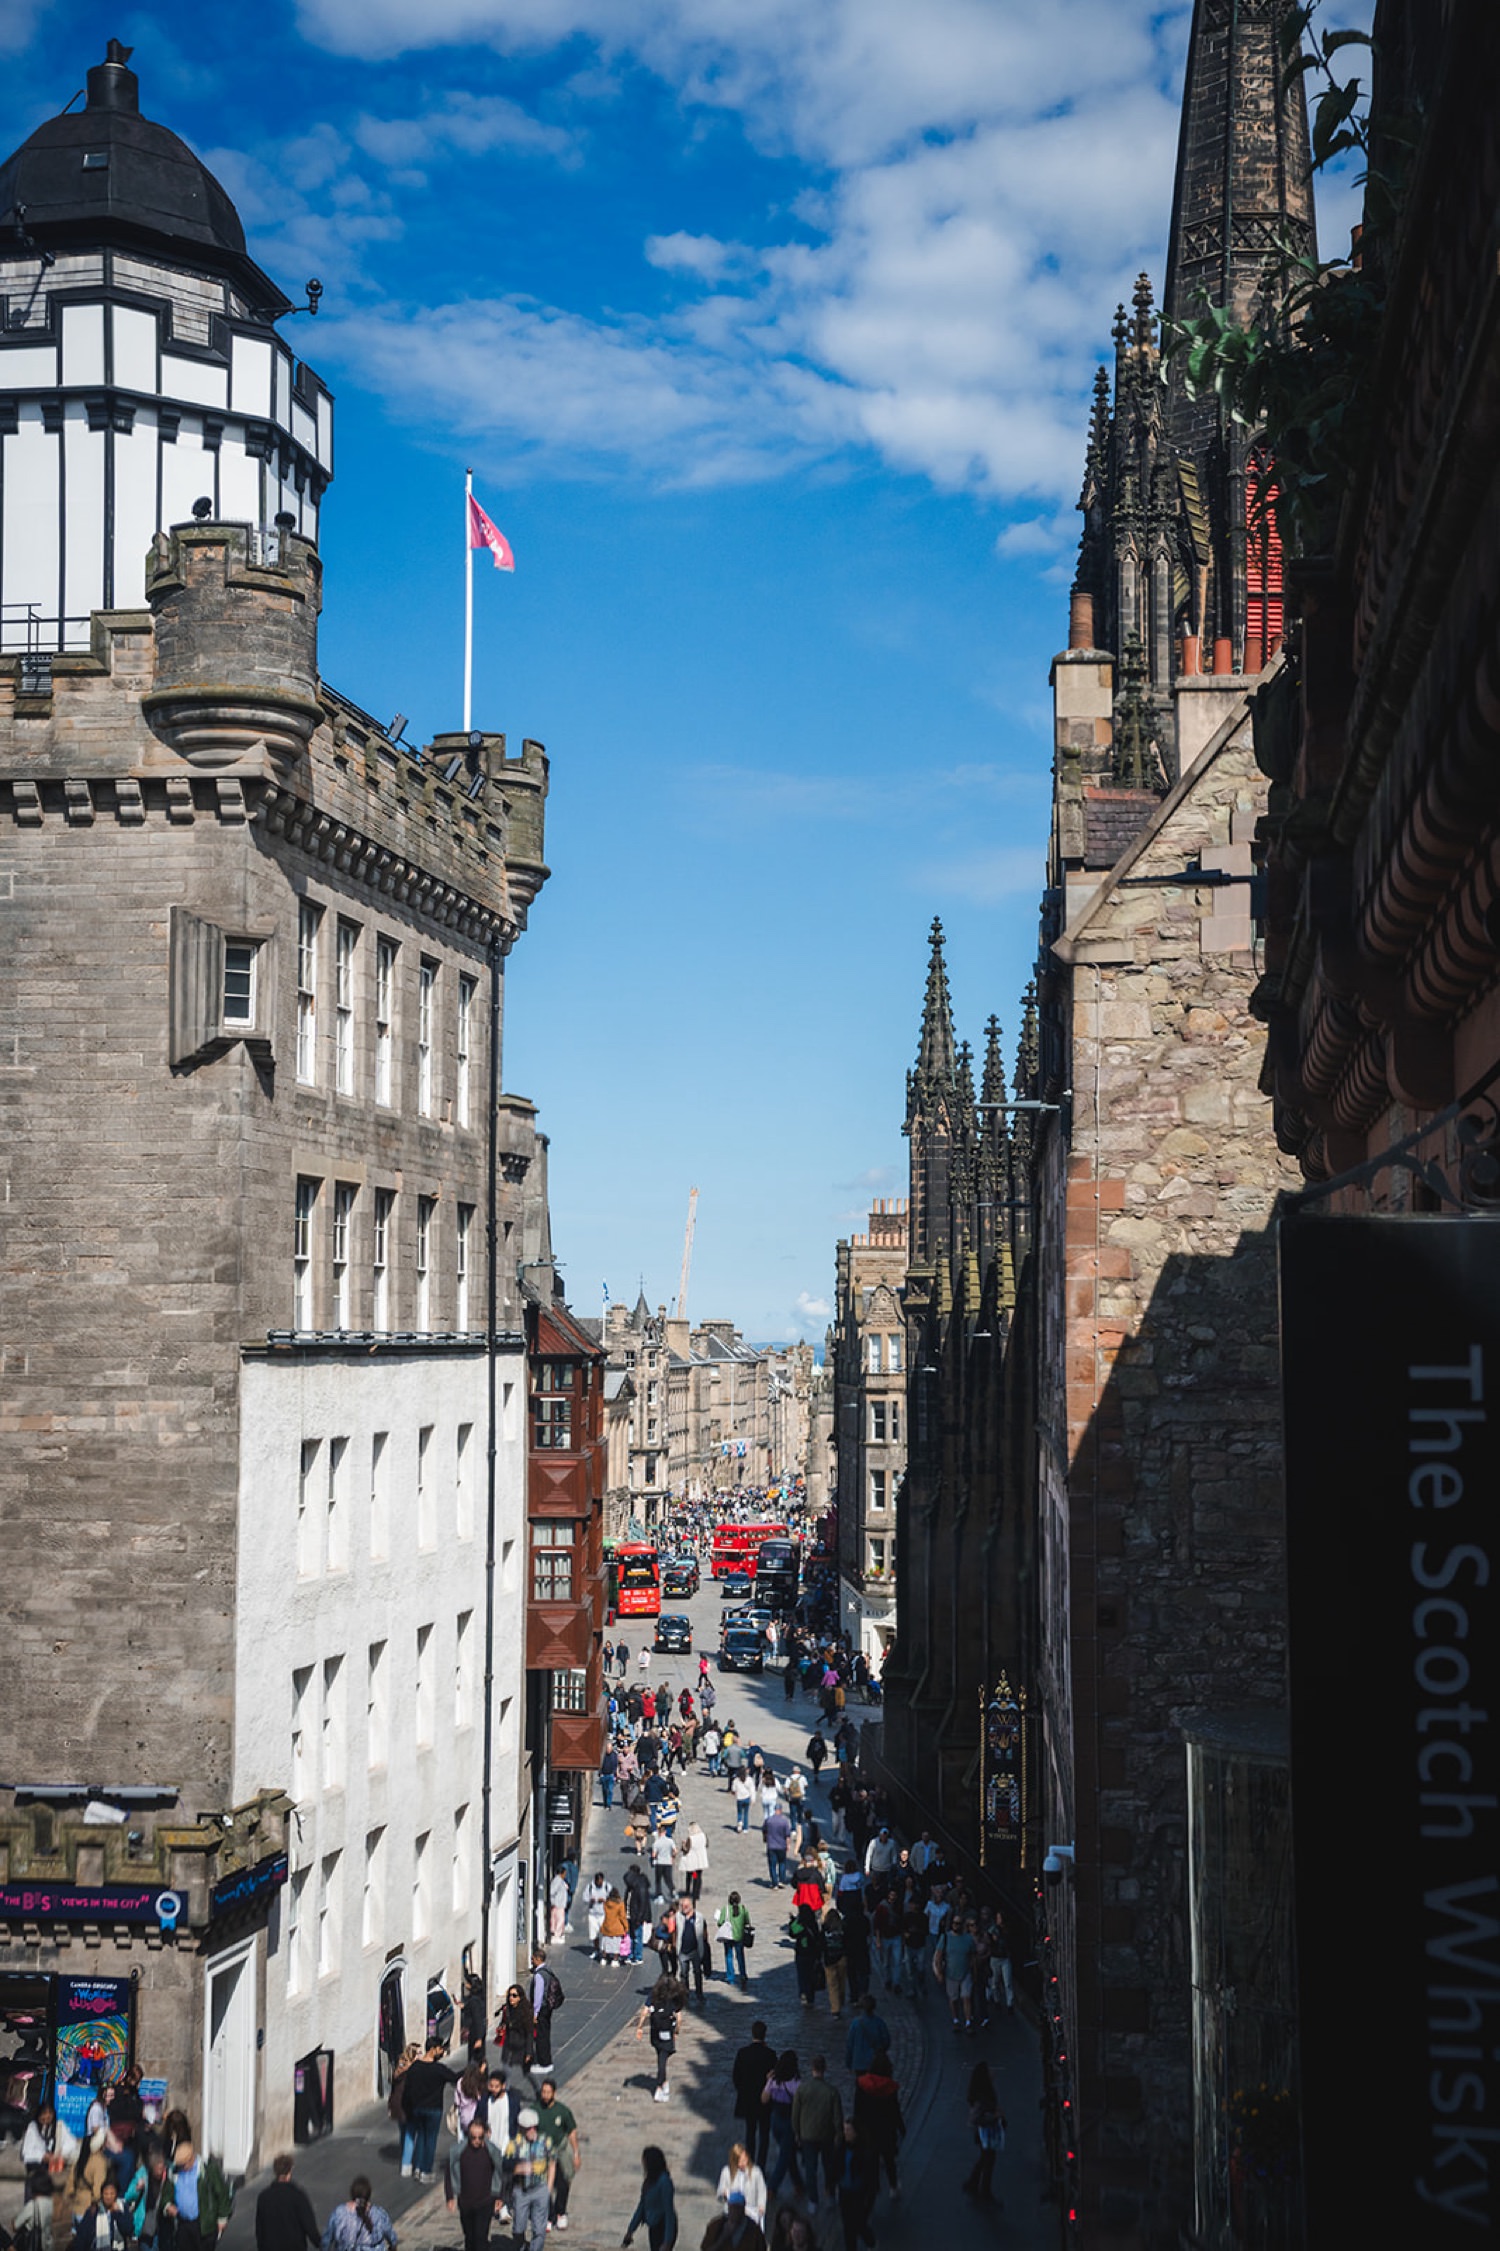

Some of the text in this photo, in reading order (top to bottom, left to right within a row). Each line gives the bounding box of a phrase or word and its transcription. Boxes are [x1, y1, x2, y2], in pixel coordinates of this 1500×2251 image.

[102, 1897, 118, 1909] THE
[1407, 1343, 1500, 2224] The Scotch Whisky
